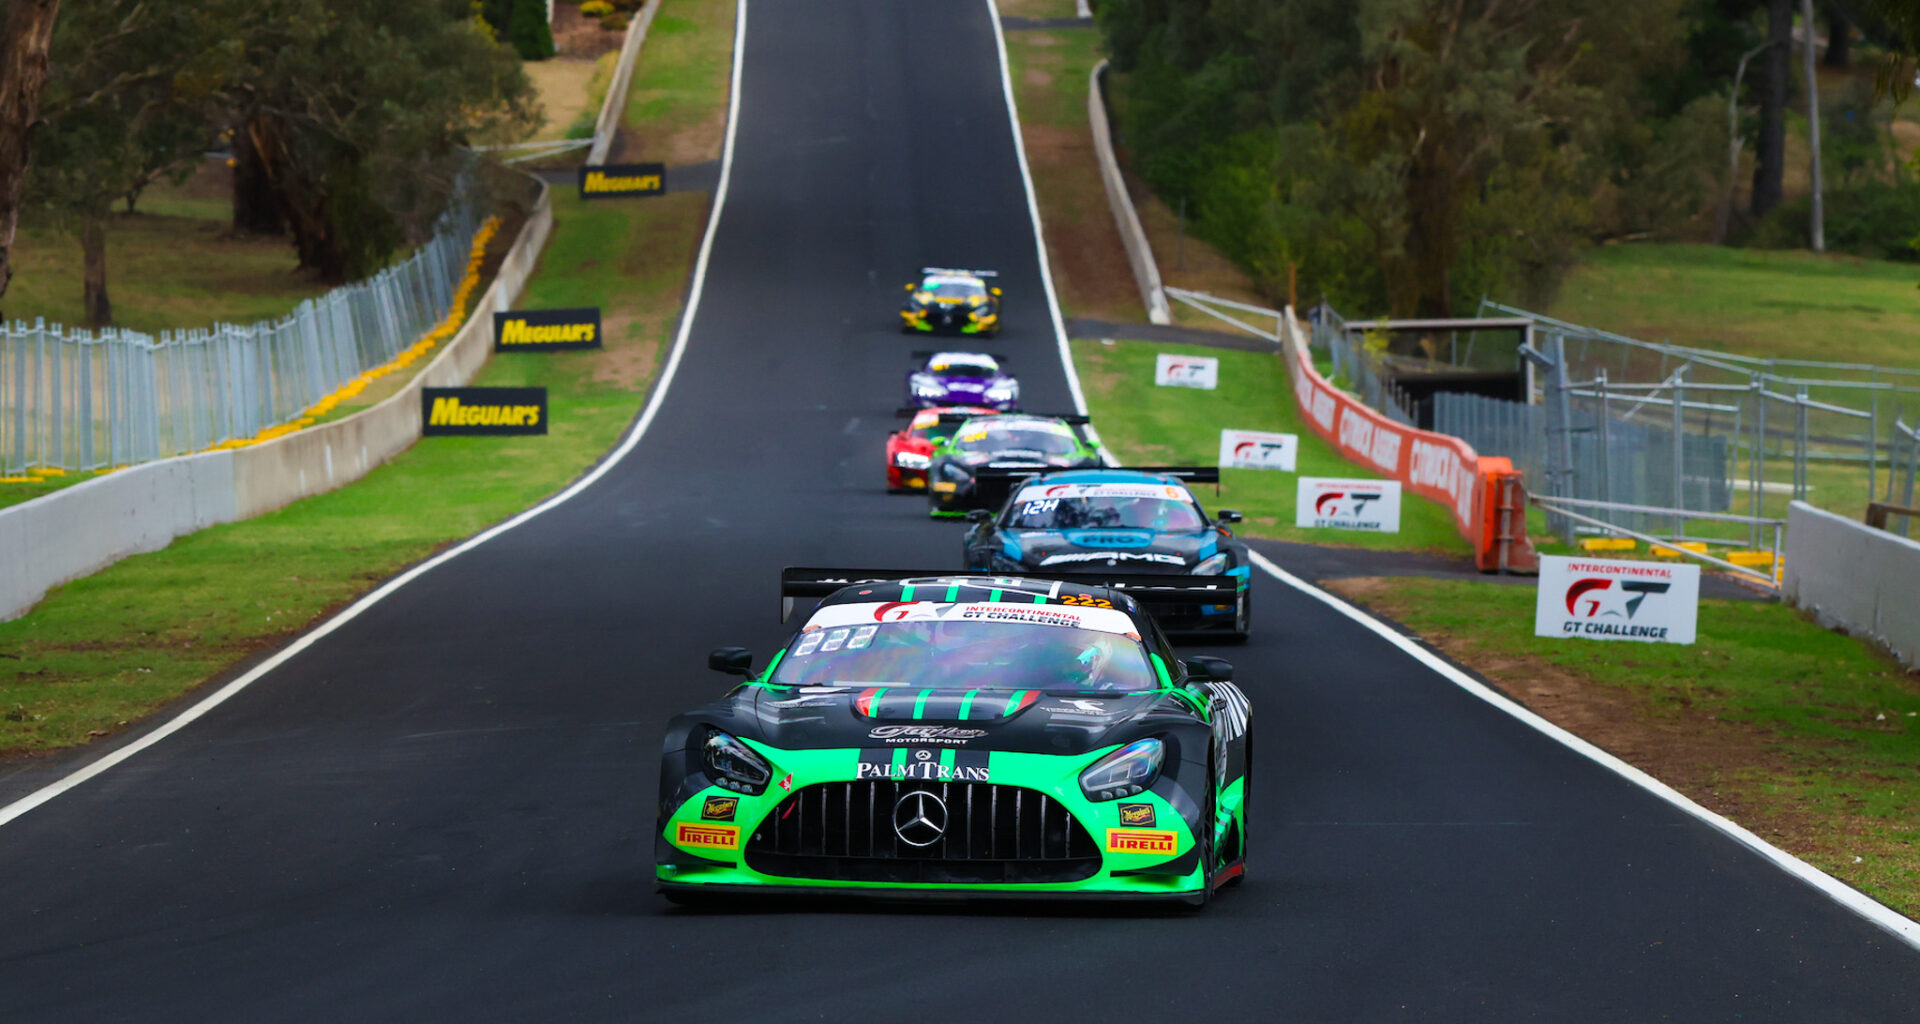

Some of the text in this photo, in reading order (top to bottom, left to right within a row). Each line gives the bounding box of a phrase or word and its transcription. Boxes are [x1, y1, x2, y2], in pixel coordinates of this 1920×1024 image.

[429, 397, 540, 426] MEGUIAR'S
[1165, 487, 1179, 498] 6
[1022, 499, 1060, 516] 12H
[1083, 535, 1136, 545] PRO
[1567, 563, 1673, 579] INTERCONTINENTAL
[1060, 595, 1114, 610] 222
[965, 606, 1082, 622] INTERCONTINENTAL
[986, 612, 1081, 629] CHALLENGE
[1563, 621, 1669, 639] GT CHALLENGE
[856, 762, 990, 781] PALM TRANS
[679, 826, 736, 846] PIRELLI
[1110, 832, 1174, 851] PIRELLI
